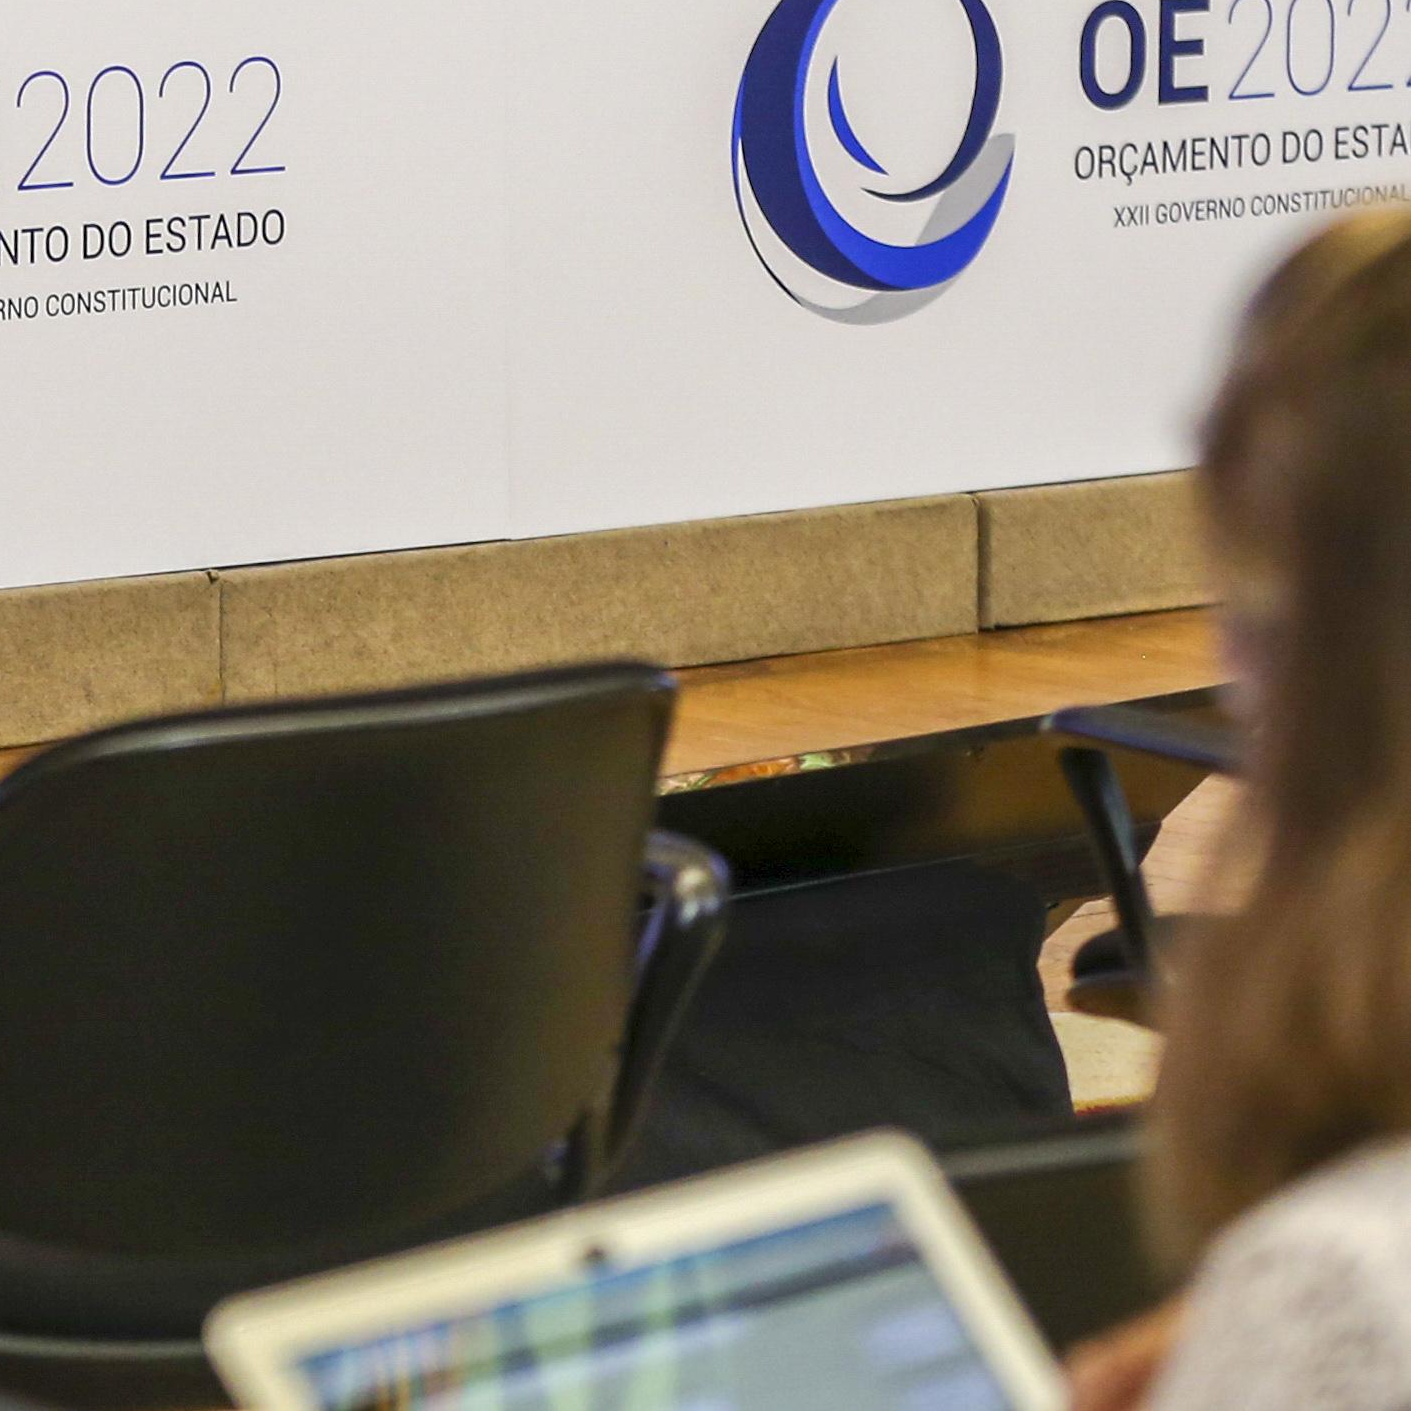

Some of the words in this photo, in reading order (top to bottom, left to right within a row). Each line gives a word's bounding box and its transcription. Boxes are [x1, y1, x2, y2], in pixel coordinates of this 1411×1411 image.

[1075, 133, 1270, 186] ORÇAMENTO
[1282, 129, 1323, 164] DO
[1335, 123, 1411, 160] ESTA
[83, 221, 131, 260] DO
[145, 209, 284, 255] ESTADO
[1113, 205, 1149, 228] XXII
[1156, 197, 1245, 225] GOVERNO
[45, 280, 237, 317] CONSTITUCIONAL
